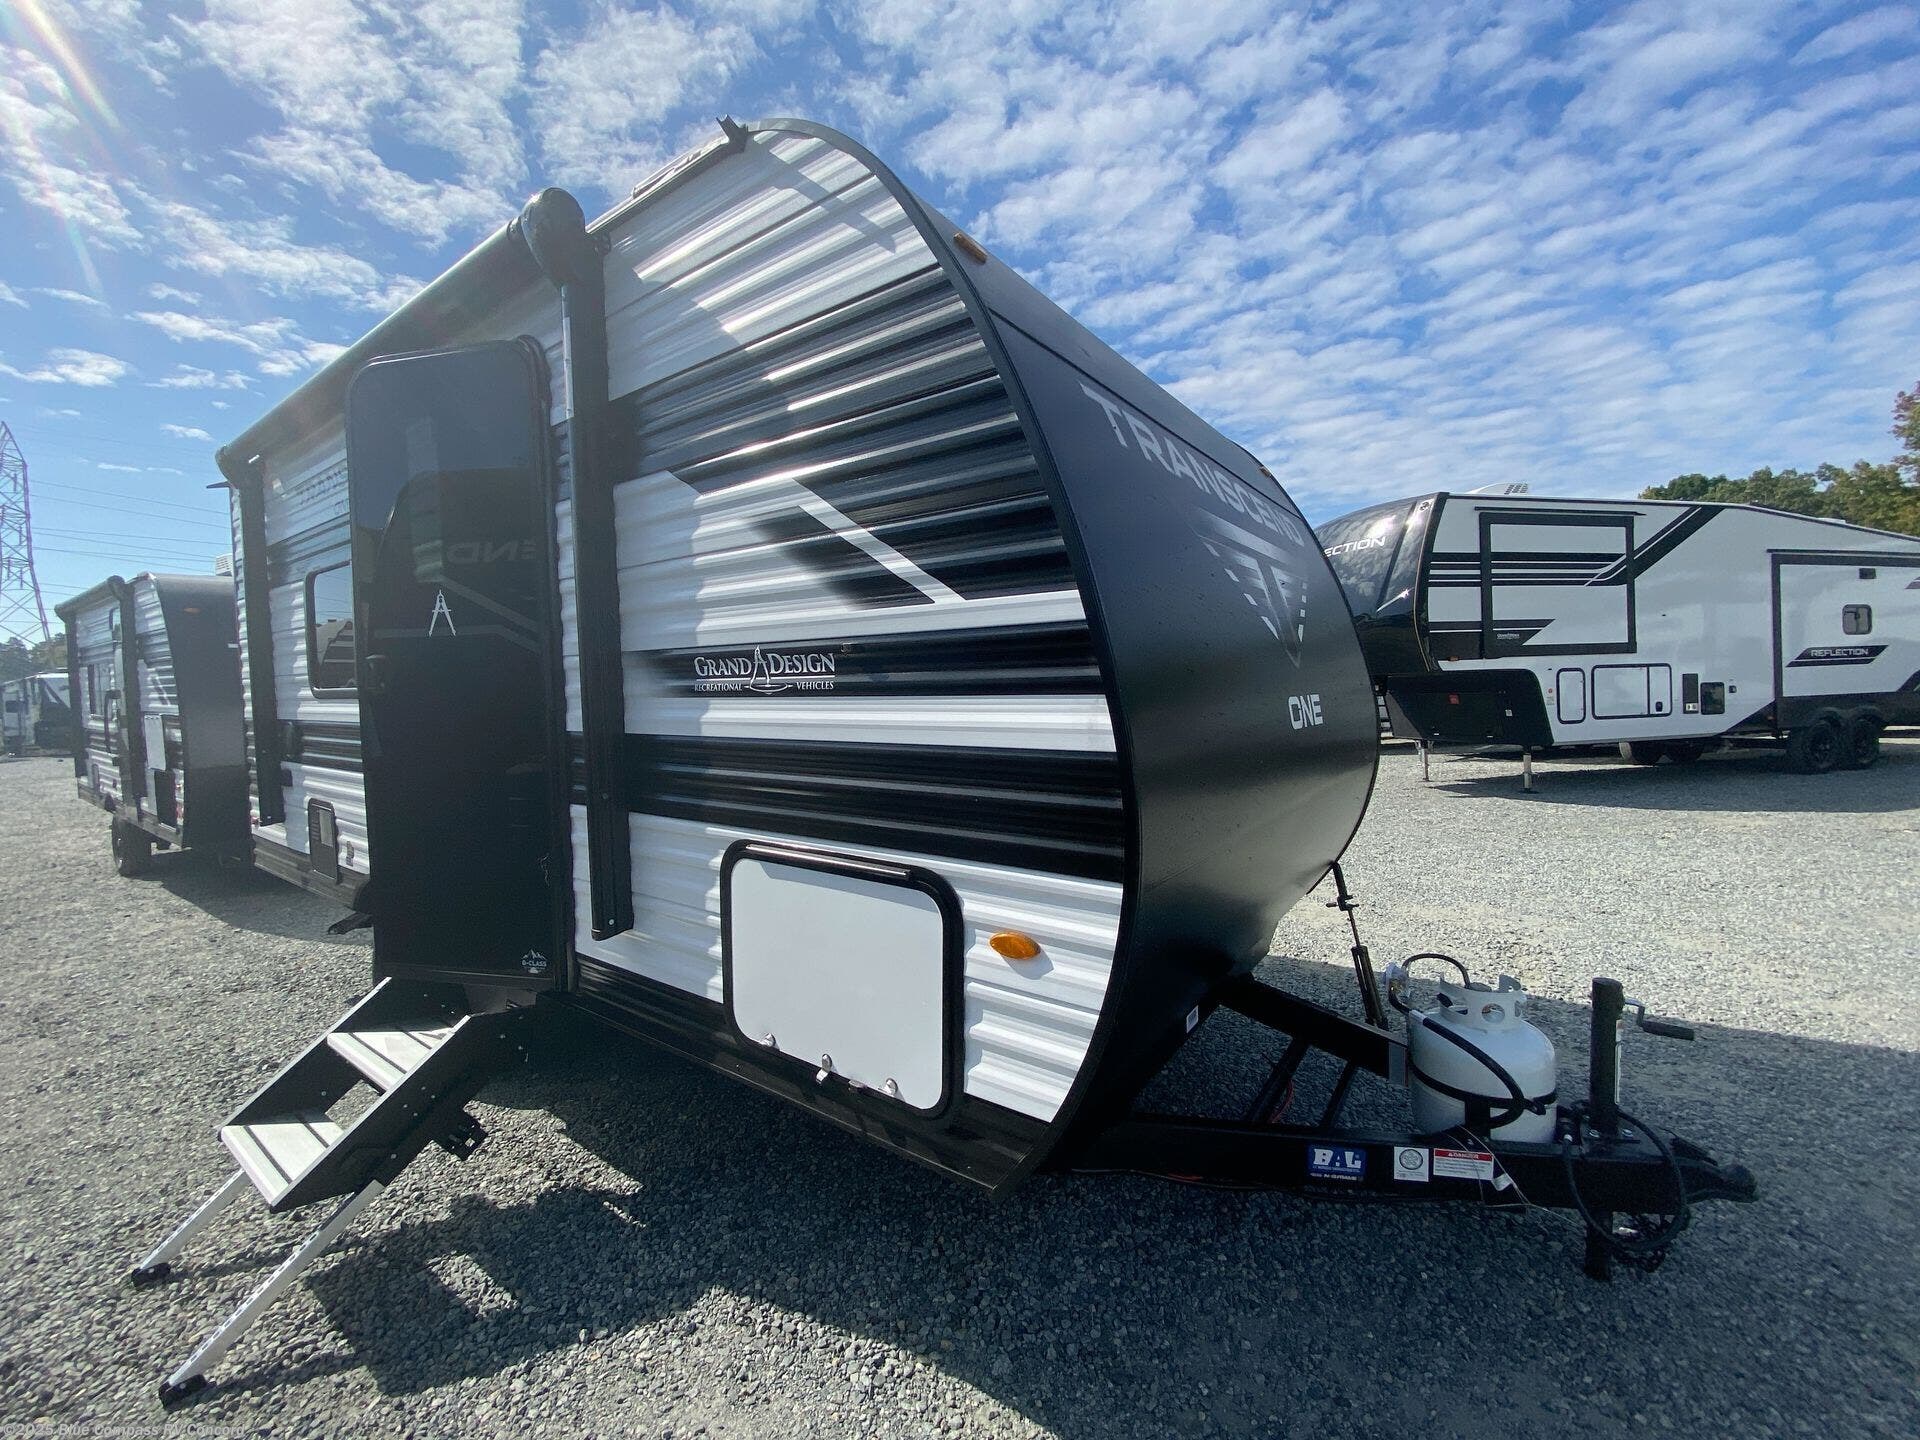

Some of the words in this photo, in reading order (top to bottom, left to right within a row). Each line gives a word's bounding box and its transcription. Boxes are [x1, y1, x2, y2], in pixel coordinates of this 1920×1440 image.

[1080, 380, 1305, 547] TRANSCEND
[694, 656, 752, 677] GRAND
[766, 652, 836, 675] DESIGN
[1810, 648, 1869, 657] REFLECTION
[694, 683, 743, 692] RECREATIONAL
[796, 681, 834, 690] VEHICLES
[1288, 693, 1324, 730] ONE
